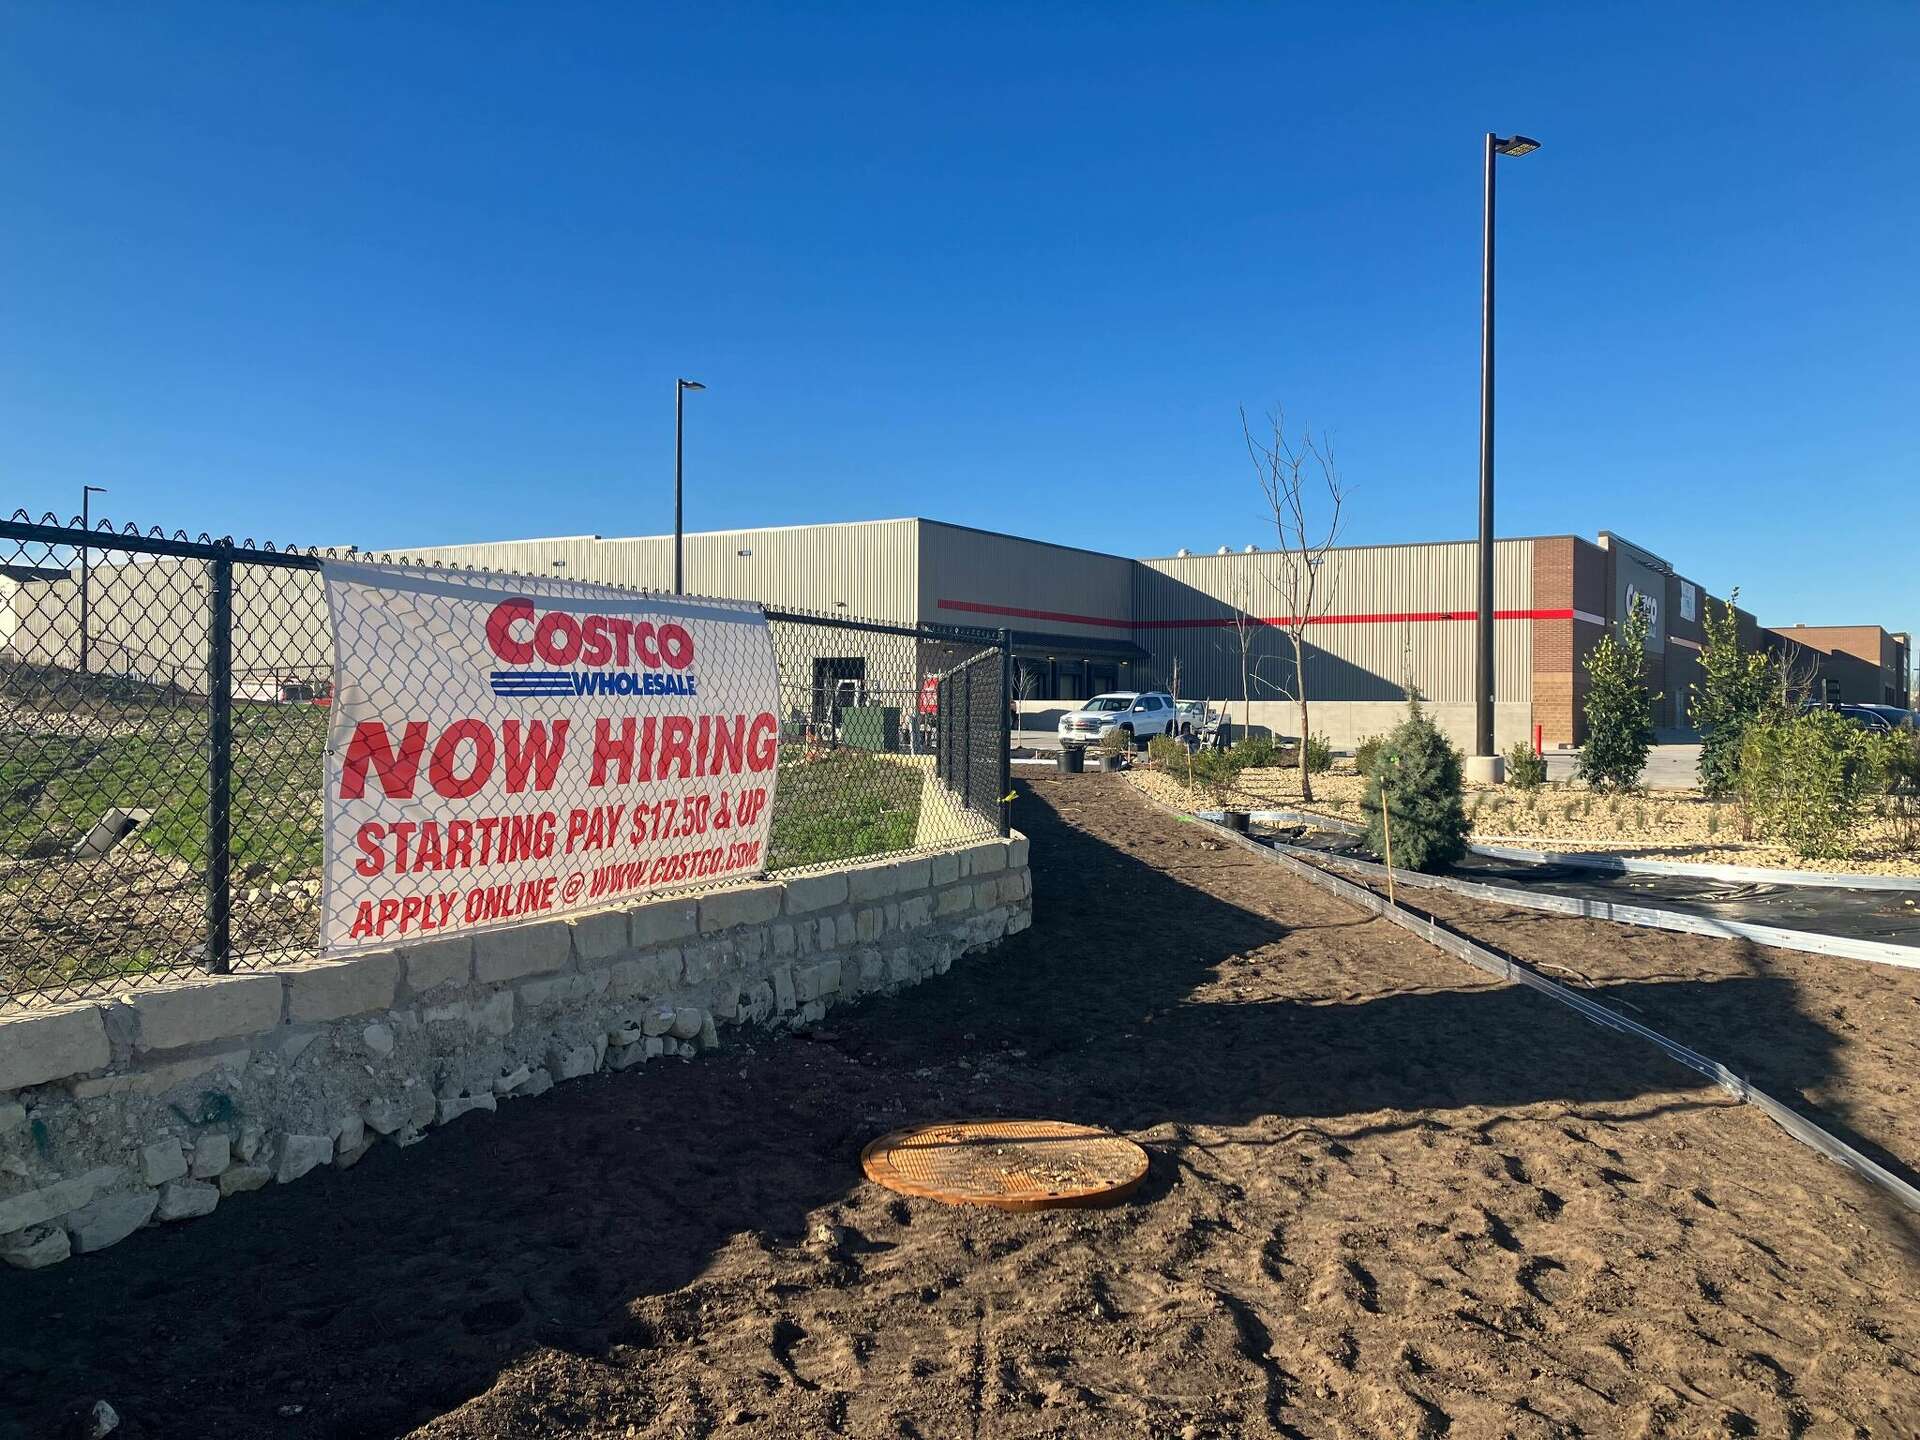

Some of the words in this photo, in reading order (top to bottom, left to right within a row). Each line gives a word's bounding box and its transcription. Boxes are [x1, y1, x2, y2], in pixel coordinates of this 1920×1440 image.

[486, 597, 694, 669] COSTCO
[571, 672, 697, 696] WHOLESALE
[339, 719, 570, 799] NOW
[589, 712, 778, 787] HIRING
[356, 811, 557, 877] STARTING
[566, 804, 626, 854] PAY
[630, 795, 710, 849] $17.50
[713, 791, 731, 830] &
[736, 788, 767, 827] UP
[350, 892, 458, 939] APPLY
[464, 877, 557, 923] ONLINE
[562, 872, 585, 904] @
[589, 840, 760, 898] WWW.COSTCO.COM
